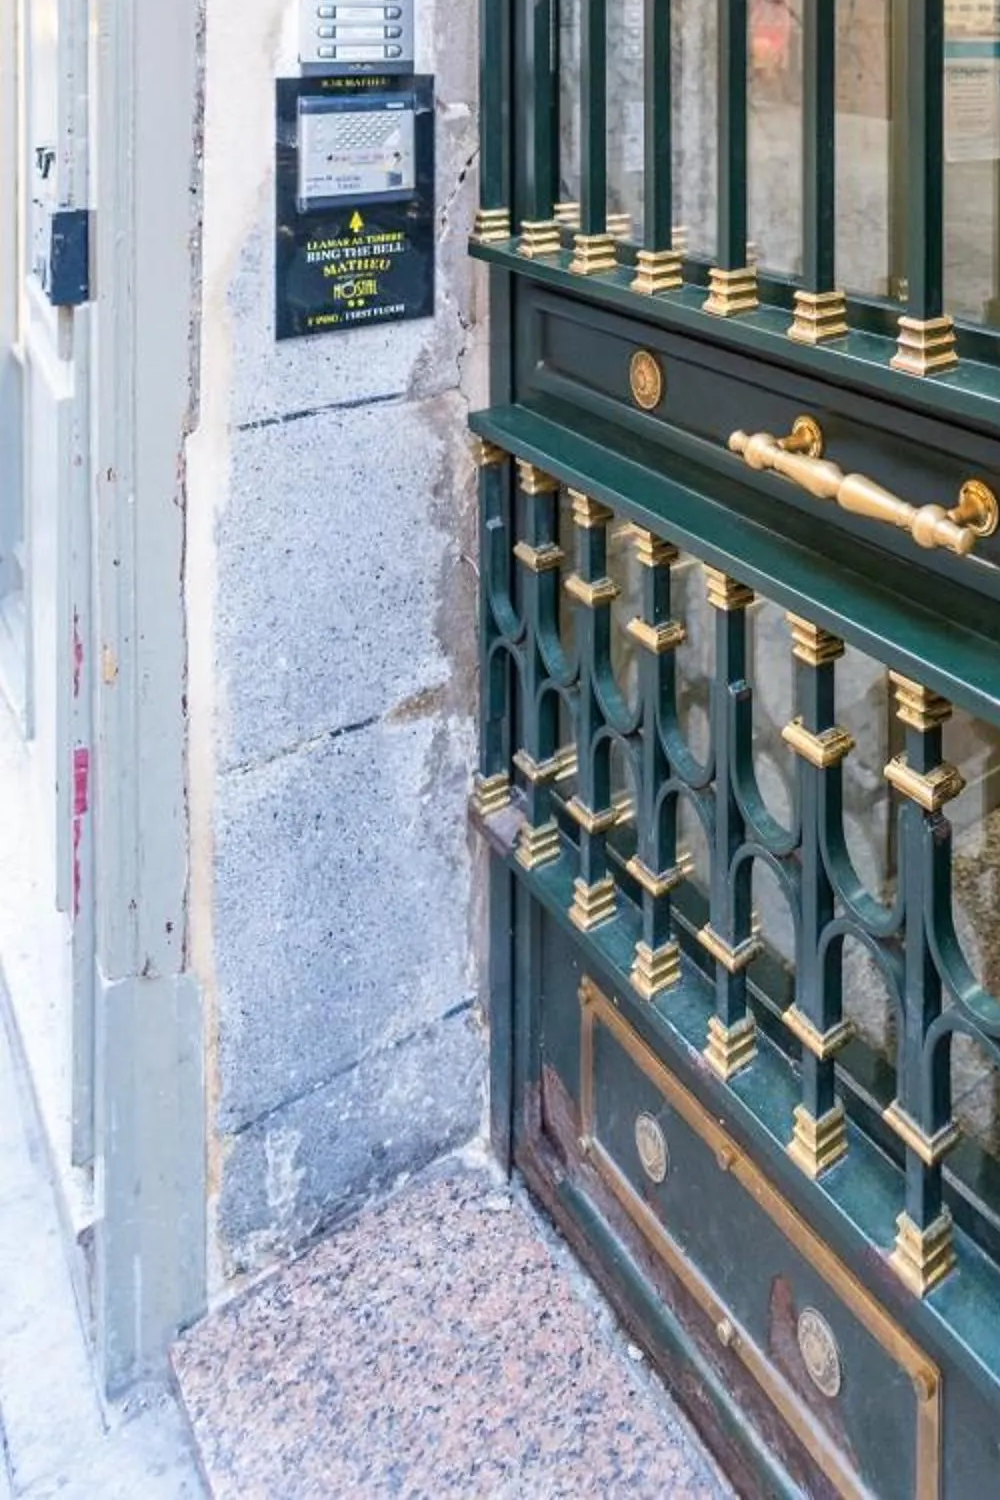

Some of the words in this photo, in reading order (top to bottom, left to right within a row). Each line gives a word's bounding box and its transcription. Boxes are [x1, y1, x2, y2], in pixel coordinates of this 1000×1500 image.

[306, 249, 341, 263] RING
[343, 246, 371, 258] THE
[373, 242, 405, 255] BELL
[323, 259, 391, 278] MATHEU
[333, 279, 378, 300] HOSTAL
